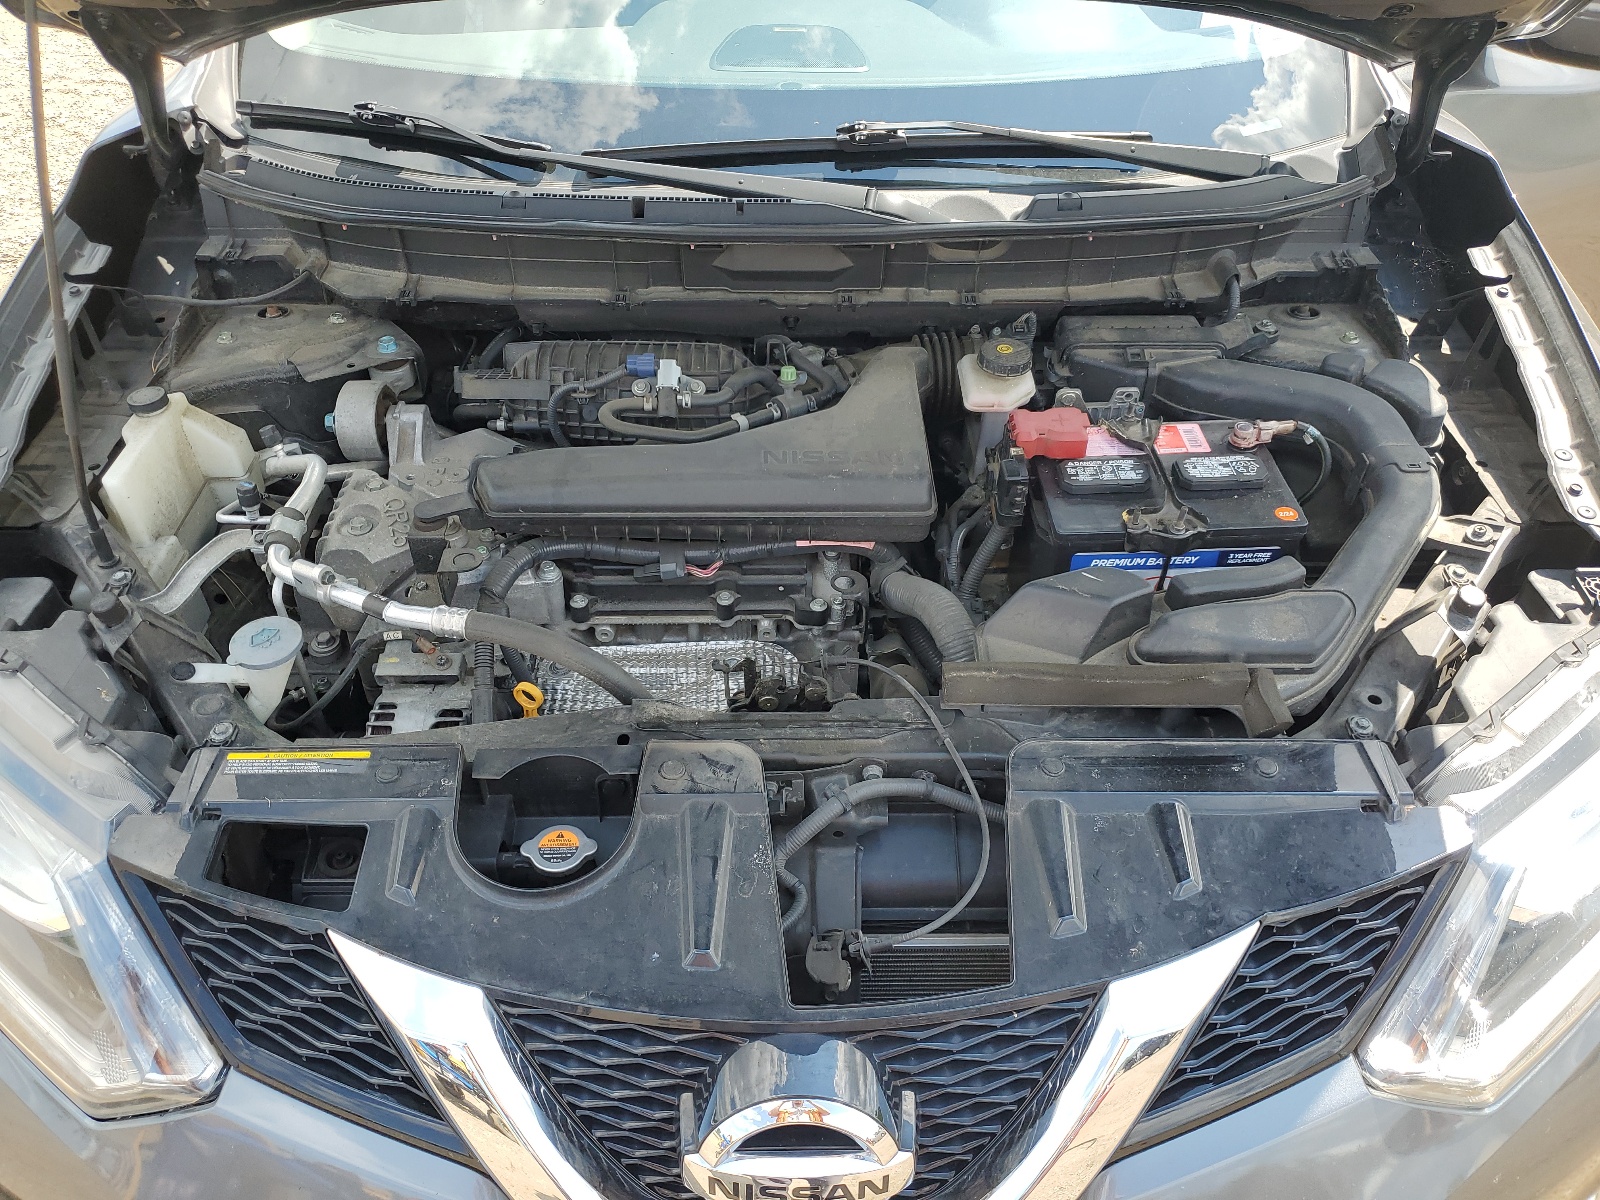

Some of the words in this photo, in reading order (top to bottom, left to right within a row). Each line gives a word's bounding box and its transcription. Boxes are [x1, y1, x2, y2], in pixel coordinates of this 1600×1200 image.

[1090, 558, 1147, 567] PREMIUM
[1145, 555, 1201, 566] BATERY
[707, 1174, 891, 1200] NISSAN
